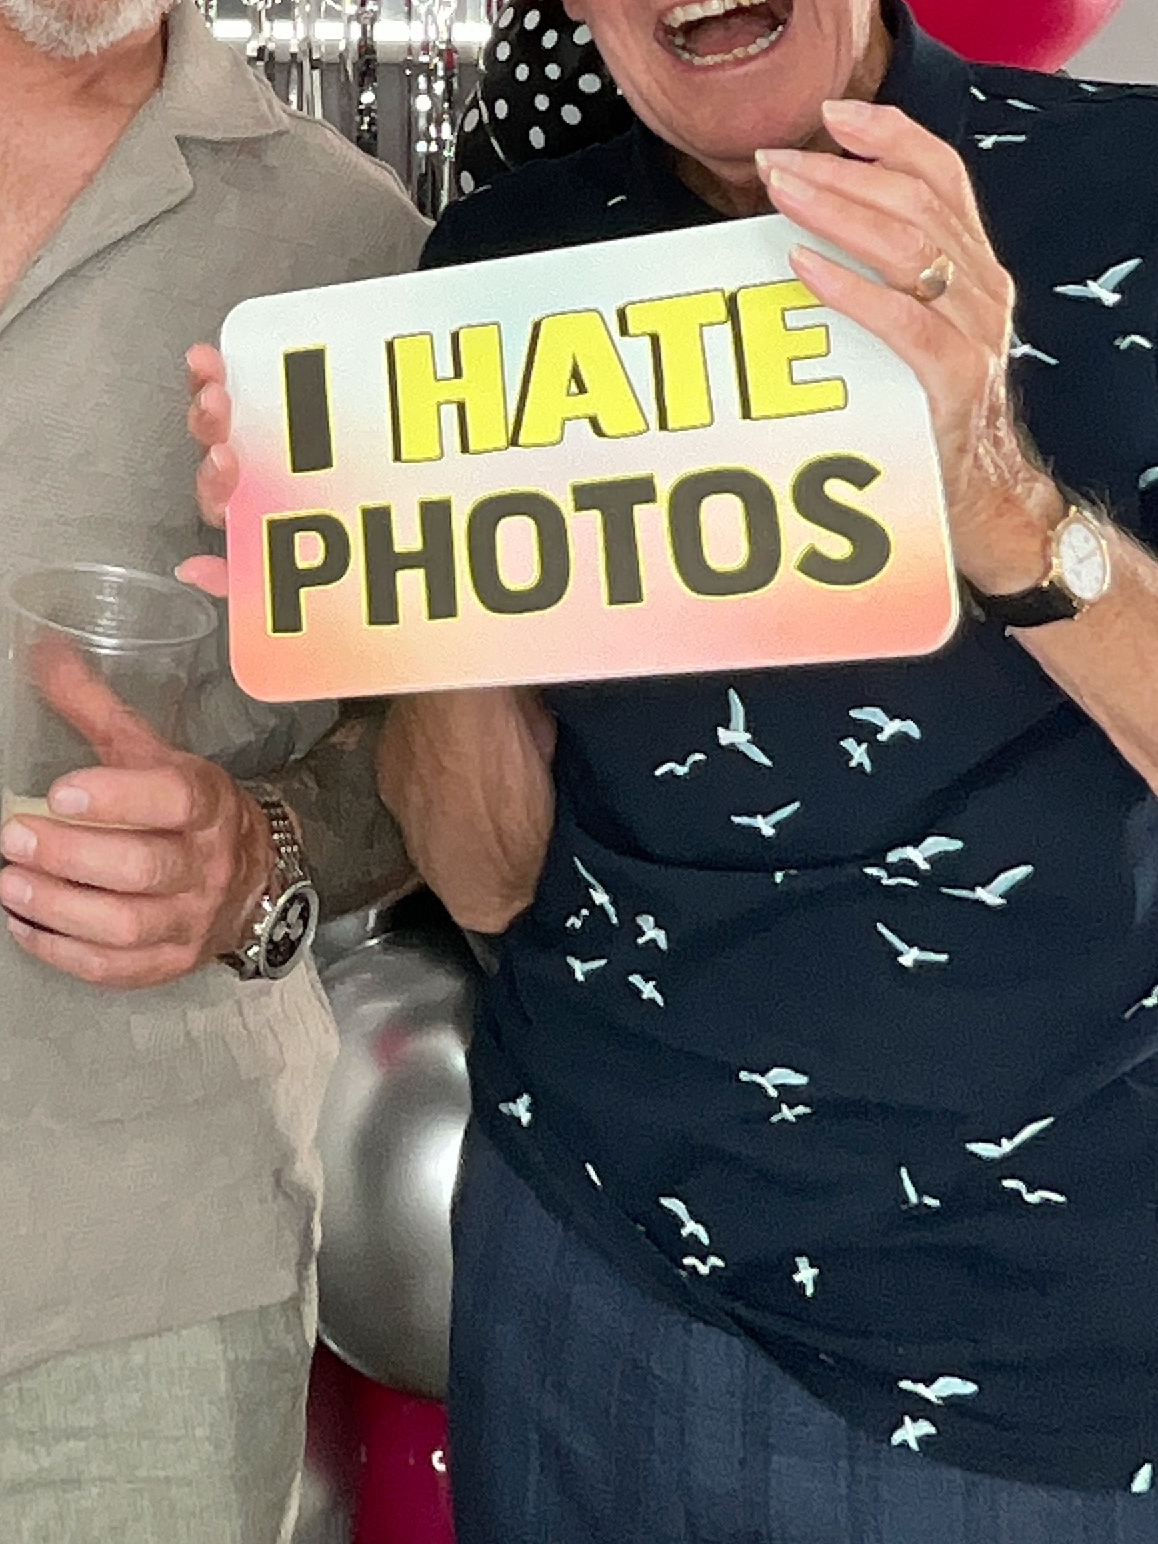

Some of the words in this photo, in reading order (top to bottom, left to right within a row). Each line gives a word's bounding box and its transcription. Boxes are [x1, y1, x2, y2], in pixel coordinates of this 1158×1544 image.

[282, 344, 334, 474] I
[385, 278, 847, 464] HATE
[263, 452, 893, 637] PHOTOS
